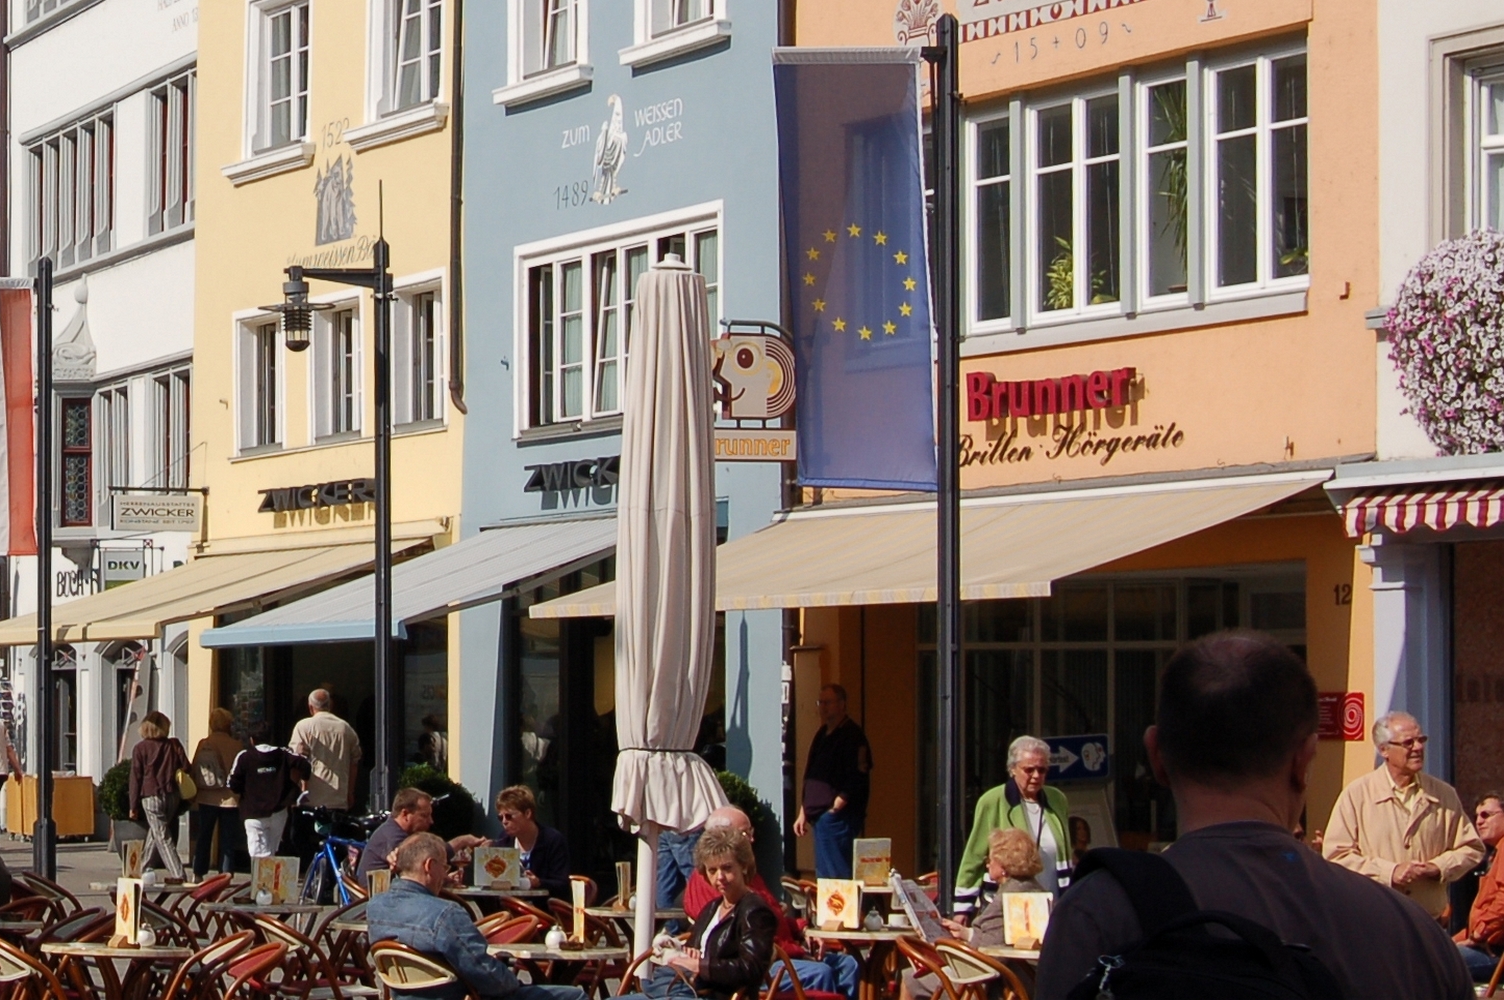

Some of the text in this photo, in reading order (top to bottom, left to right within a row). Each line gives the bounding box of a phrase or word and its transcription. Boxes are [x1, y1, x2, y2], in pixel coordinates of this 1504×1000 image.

[634, 121, 683, 156] ADLER
[553, 180, 588, 210] 1489
[966, 367, 1137, 422] Brunner
[715, 437, 791, 456] runner
[959, 422, 1185, 467] Brillen Hörgeräte
[524, 455, 621, 493] ZWICK
[258, 477, 376, 513] ZWICKER
[120, 507, 195, 517] ZWICKER
[108, 560, 140, 570] DKV
[1333, 583, 1352, 606] 12
